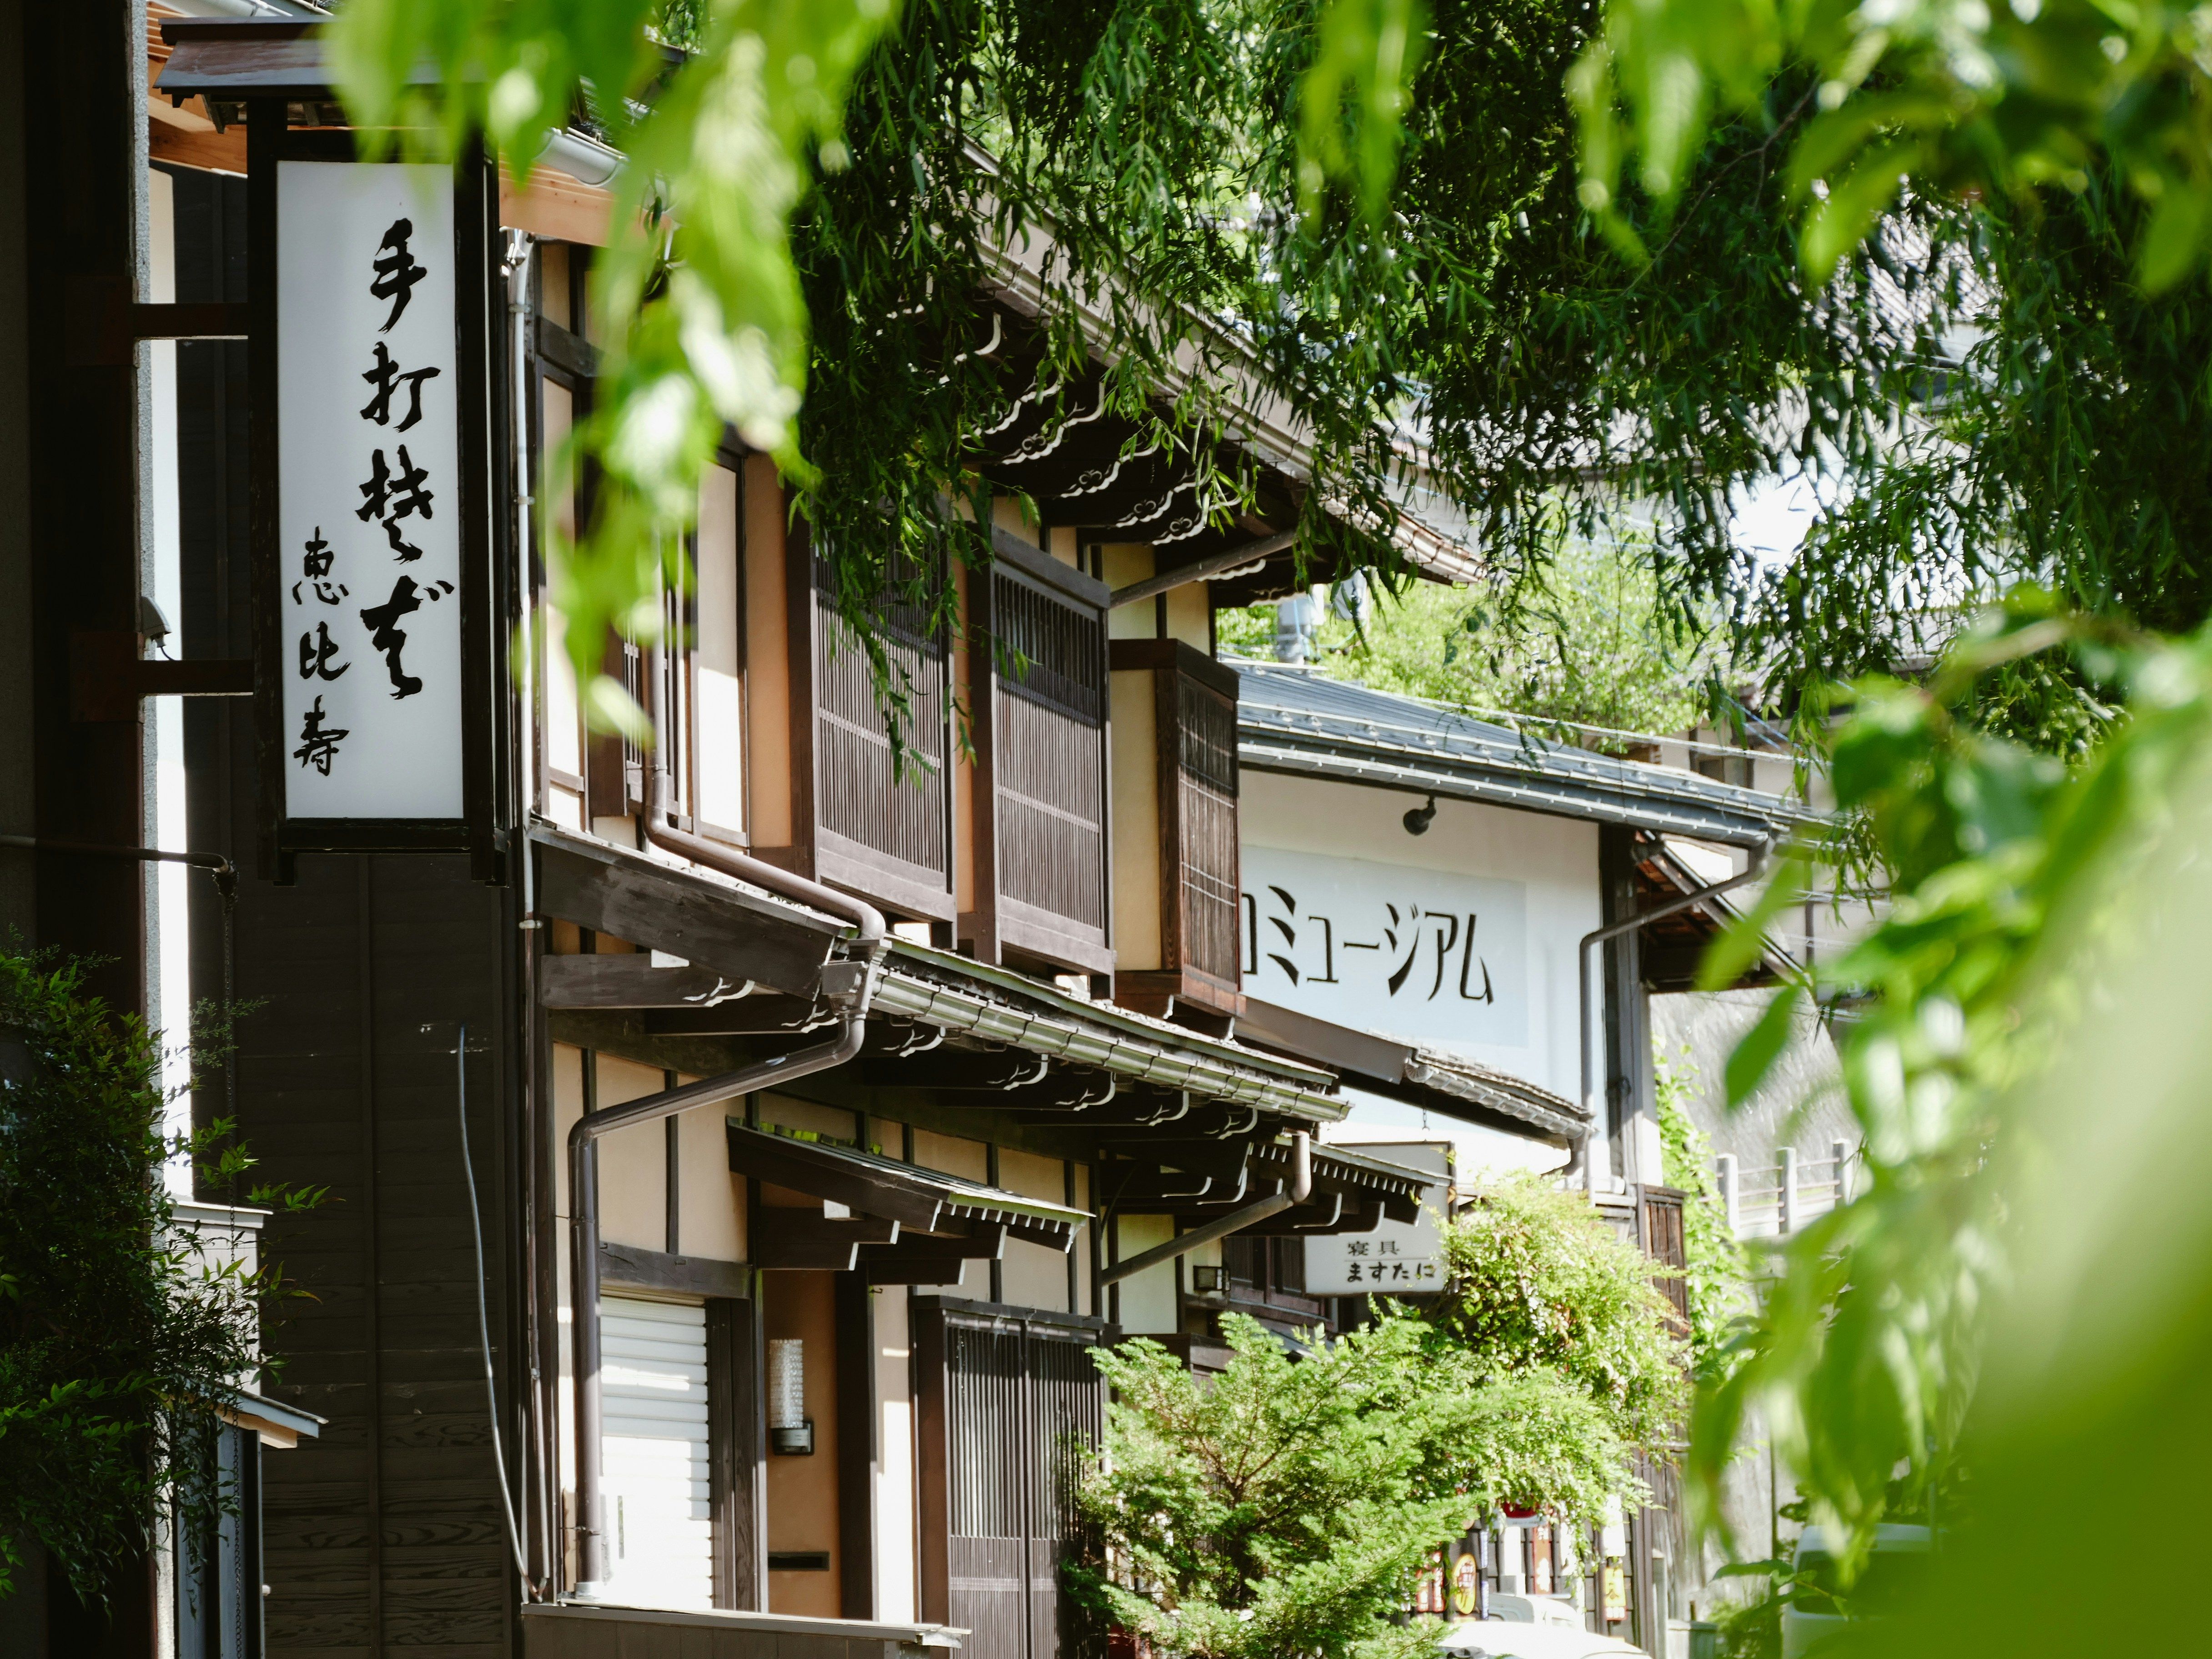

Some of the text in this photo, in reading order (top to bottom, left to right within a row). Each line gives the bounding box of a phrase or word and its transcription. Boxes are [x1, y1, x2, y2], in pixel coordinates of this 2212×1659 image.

[292, 526, 351, 776] 恵比寿
[1347, 1240, 1400, 1256] 寝具
[1347, 1261, 1435, 1283] ますたに
